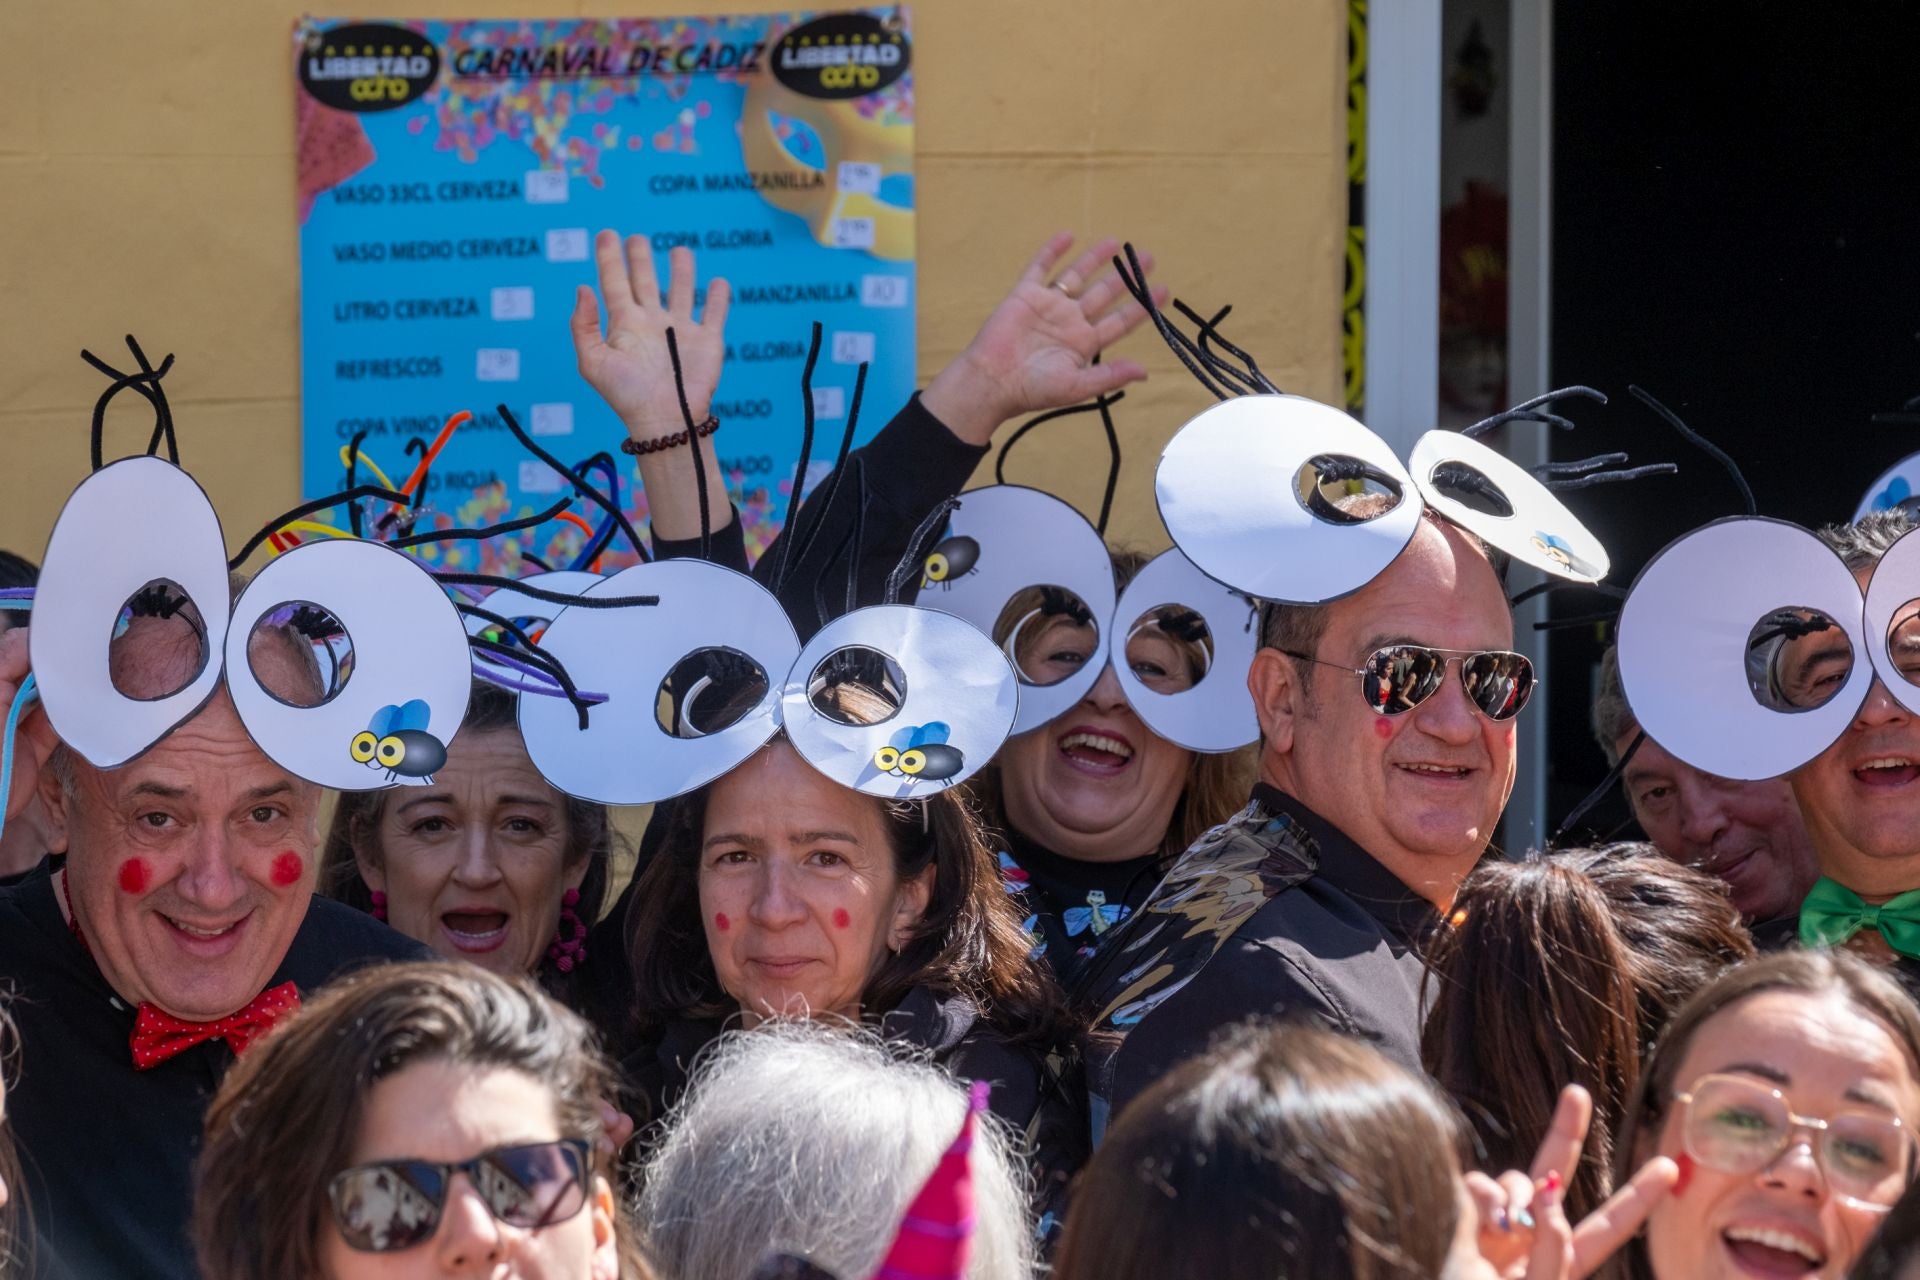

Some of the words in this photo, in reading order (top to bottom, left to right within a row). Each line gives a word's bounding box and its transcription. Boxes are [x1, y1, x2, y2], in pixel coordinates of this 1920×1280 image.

[308, 54, 431, 80] LIBERTAD
[454, 46, 617, 75] CARNAVAL
[628, 46, 668, 71] DE
[781, 43, 901, 69] LIBERTAD
[333, 184, 384, 205] VASO
[438, 180, 521, 202] CERVEZA
[649, 175, 700, 194] COPA
[705, 171, 825, 192] MANZANILLA
[334, 243, 384, 263] VASO
[390, 240, 451, 260] MEDIO
[456, 237, 540, 258] CERVEZA
[650, 231, 701, 250] COPA
[706, 229, 774, 248] GLORIA
[739, 282, 858, 304] MANZANILLA
[334, 301, 389, 322] LITRO
[394, 298, 479, 319] CERVEZA
[739, 342, 806, 361] GLORIA
[335, 357, 443, 379] REFRESCOS
[336, 417, 389, 438] COPA
[394, 415, 439, 435] VINO
[445, 469, 500, 488] RIOJA
